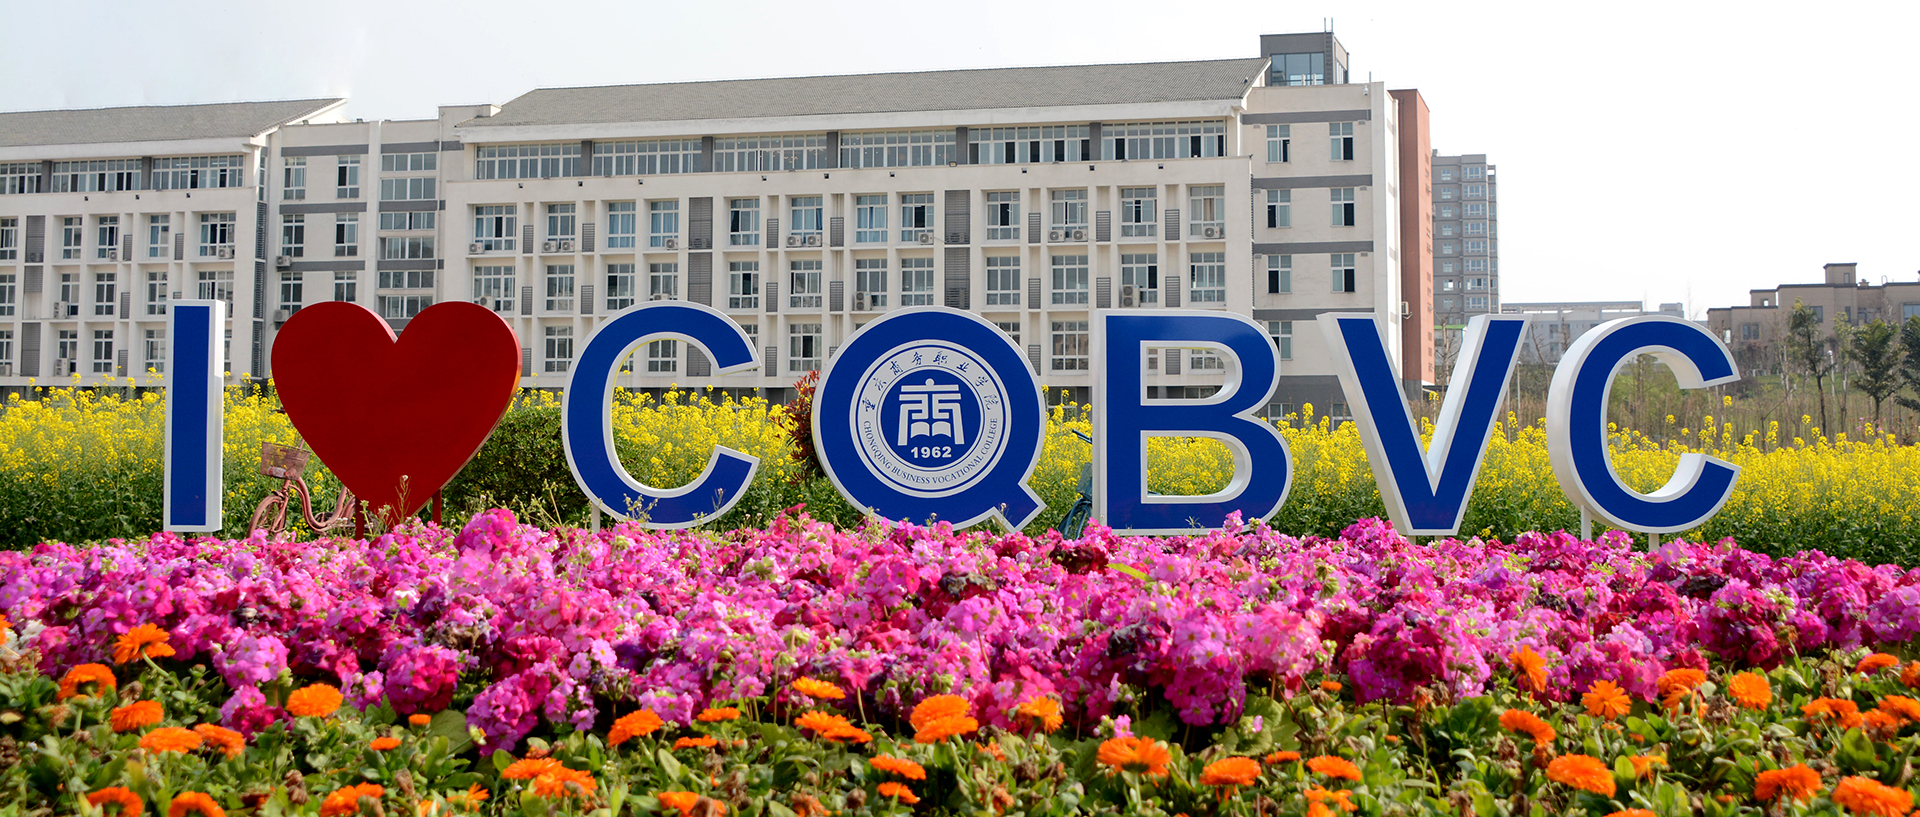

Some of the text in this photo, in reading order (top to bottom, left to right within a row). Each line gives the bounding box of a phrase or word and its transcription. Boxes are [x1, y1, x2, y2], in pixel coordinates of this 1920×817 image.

[164, 300, 1740, 537] I CQBVC
[863, 417, 998, 484] CHONGQING BUSINESS VOCATIONAL COLLEGE
[910, 446, 952, 459] 1962
